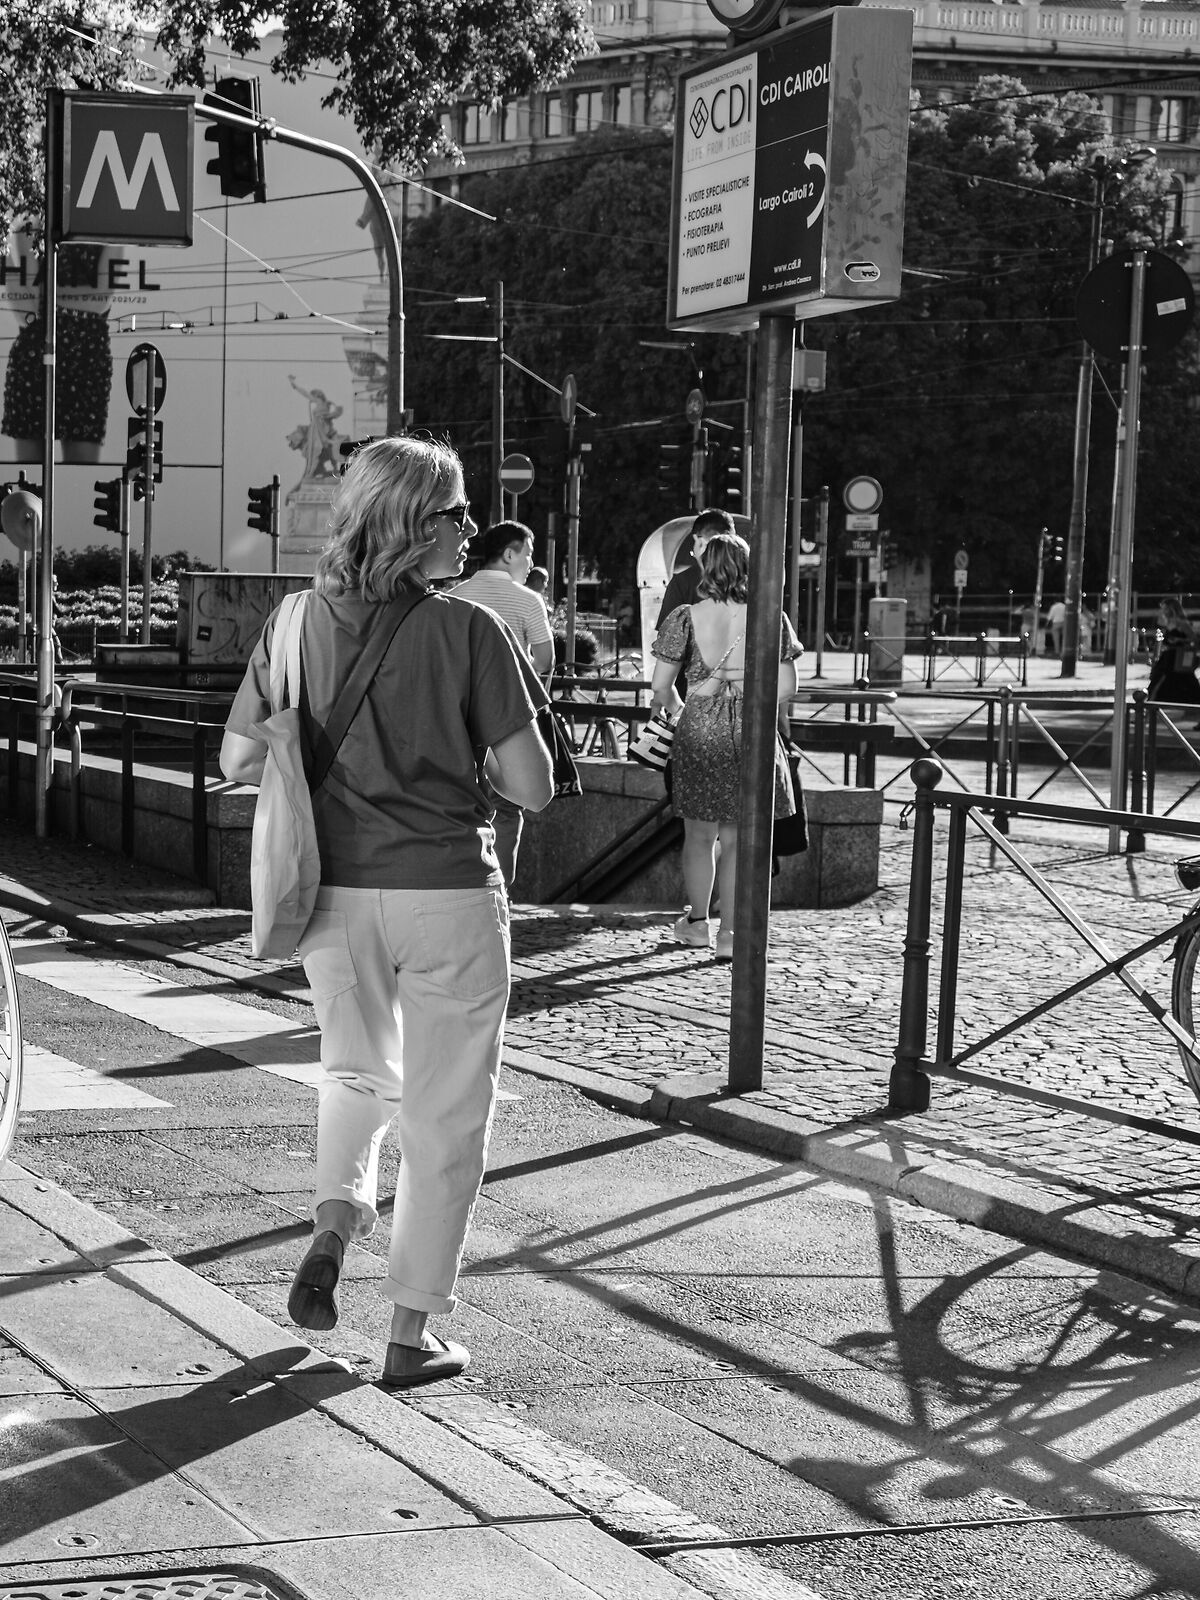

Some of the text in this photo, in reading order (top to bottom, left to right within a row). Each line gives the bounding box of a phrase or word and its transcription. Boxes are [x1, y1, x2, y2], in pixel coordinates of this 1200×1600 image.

[760, 62, 831, 106] CDI CAIROLI
[711, 79, 751, 133] CDI
[728, 130, 751, 150] INSIDE
[76, 130, 180, 211] M
[706, 176, 750, 198] SPECIALISTICHE
[759, 182, 814, 211] Largo Cairoli 2
[688, 203, 722, 221] ECOGRAFIA
[687, 221, 724, 239] FISIOTERAPIA
[686, 238, 730, 258] PUNTO PRELIEVI
